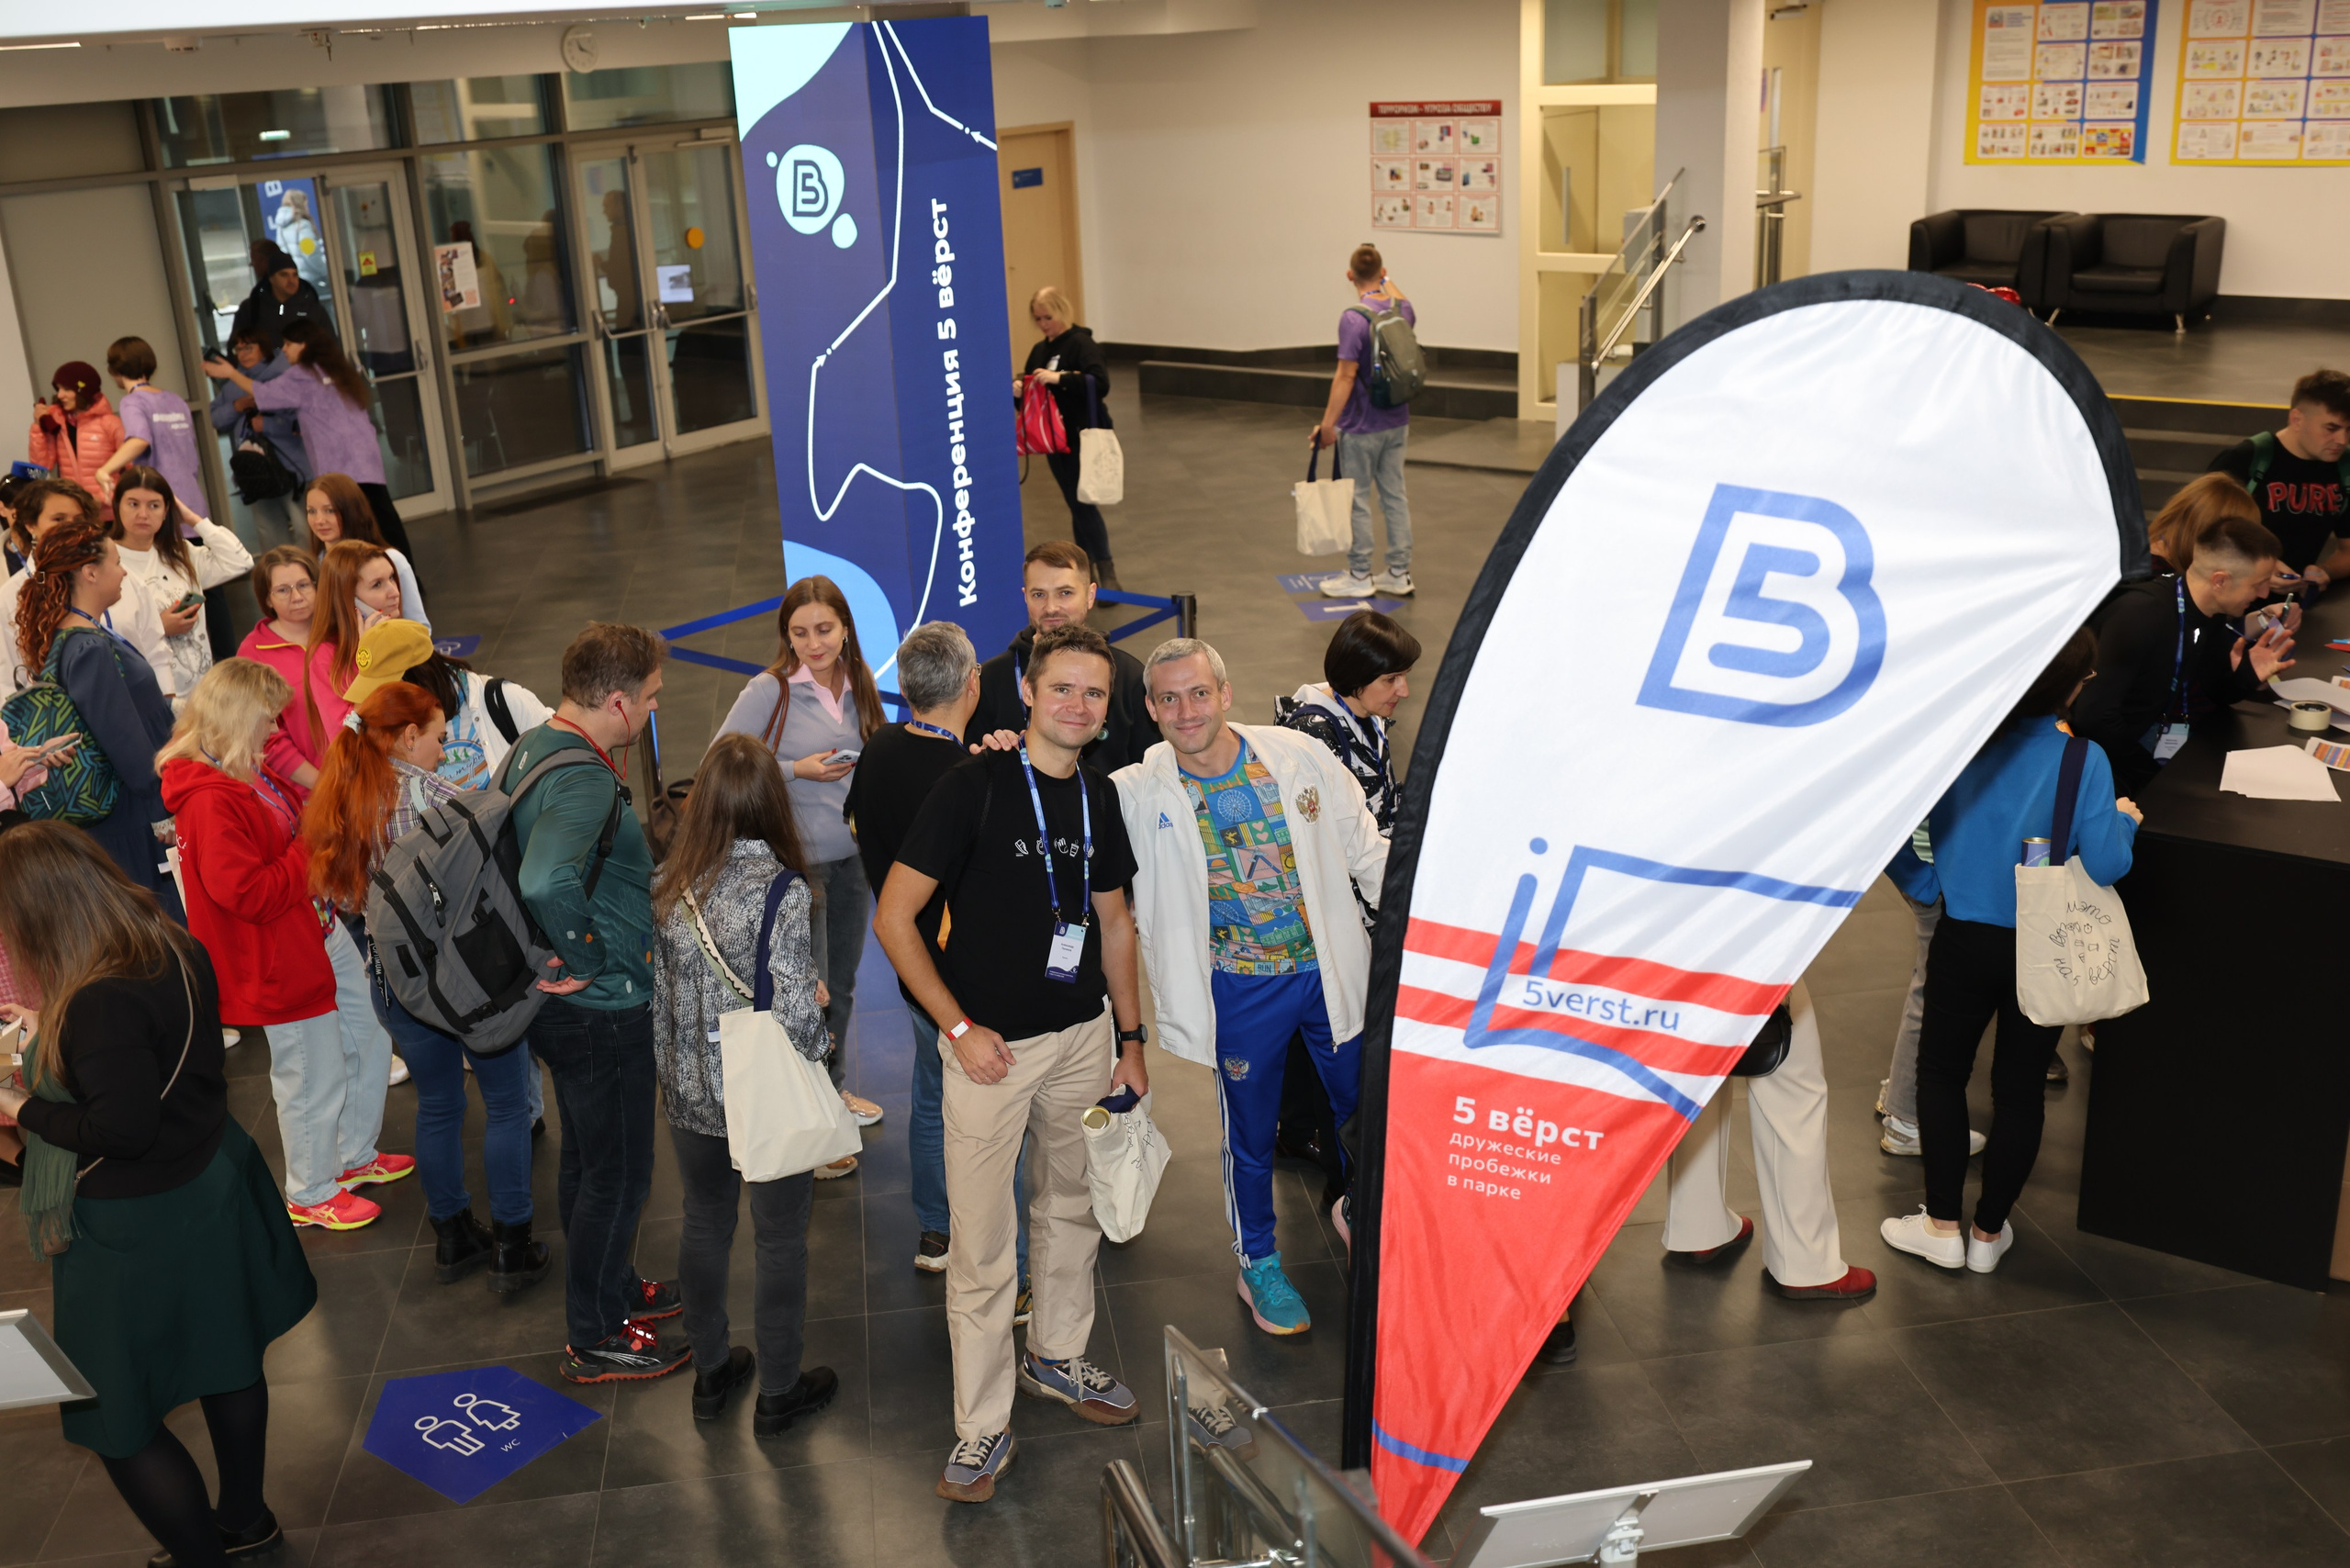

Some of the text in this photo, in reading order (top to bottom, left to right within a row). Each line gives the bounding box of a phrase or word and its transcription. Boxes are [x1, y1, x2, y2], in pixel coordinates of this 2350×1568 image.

[931, 197, 978, 607] Конференция 5 вёрст
[2266, 482, 2344, 516] PURE
[1257, 964, 1272, 973] RUN
[1522, 980, 1680, 1031] 5verst.ru
[1452, 1095, 1605, 1150] 5 вёрст
[1449, 1132, 1561, 1165] дружеские
[1448, 1153, 1551, 1184] пробежки
[1447, 1175, 1521, 1200] в парке
[500, 1439, 520, 1451] WC
